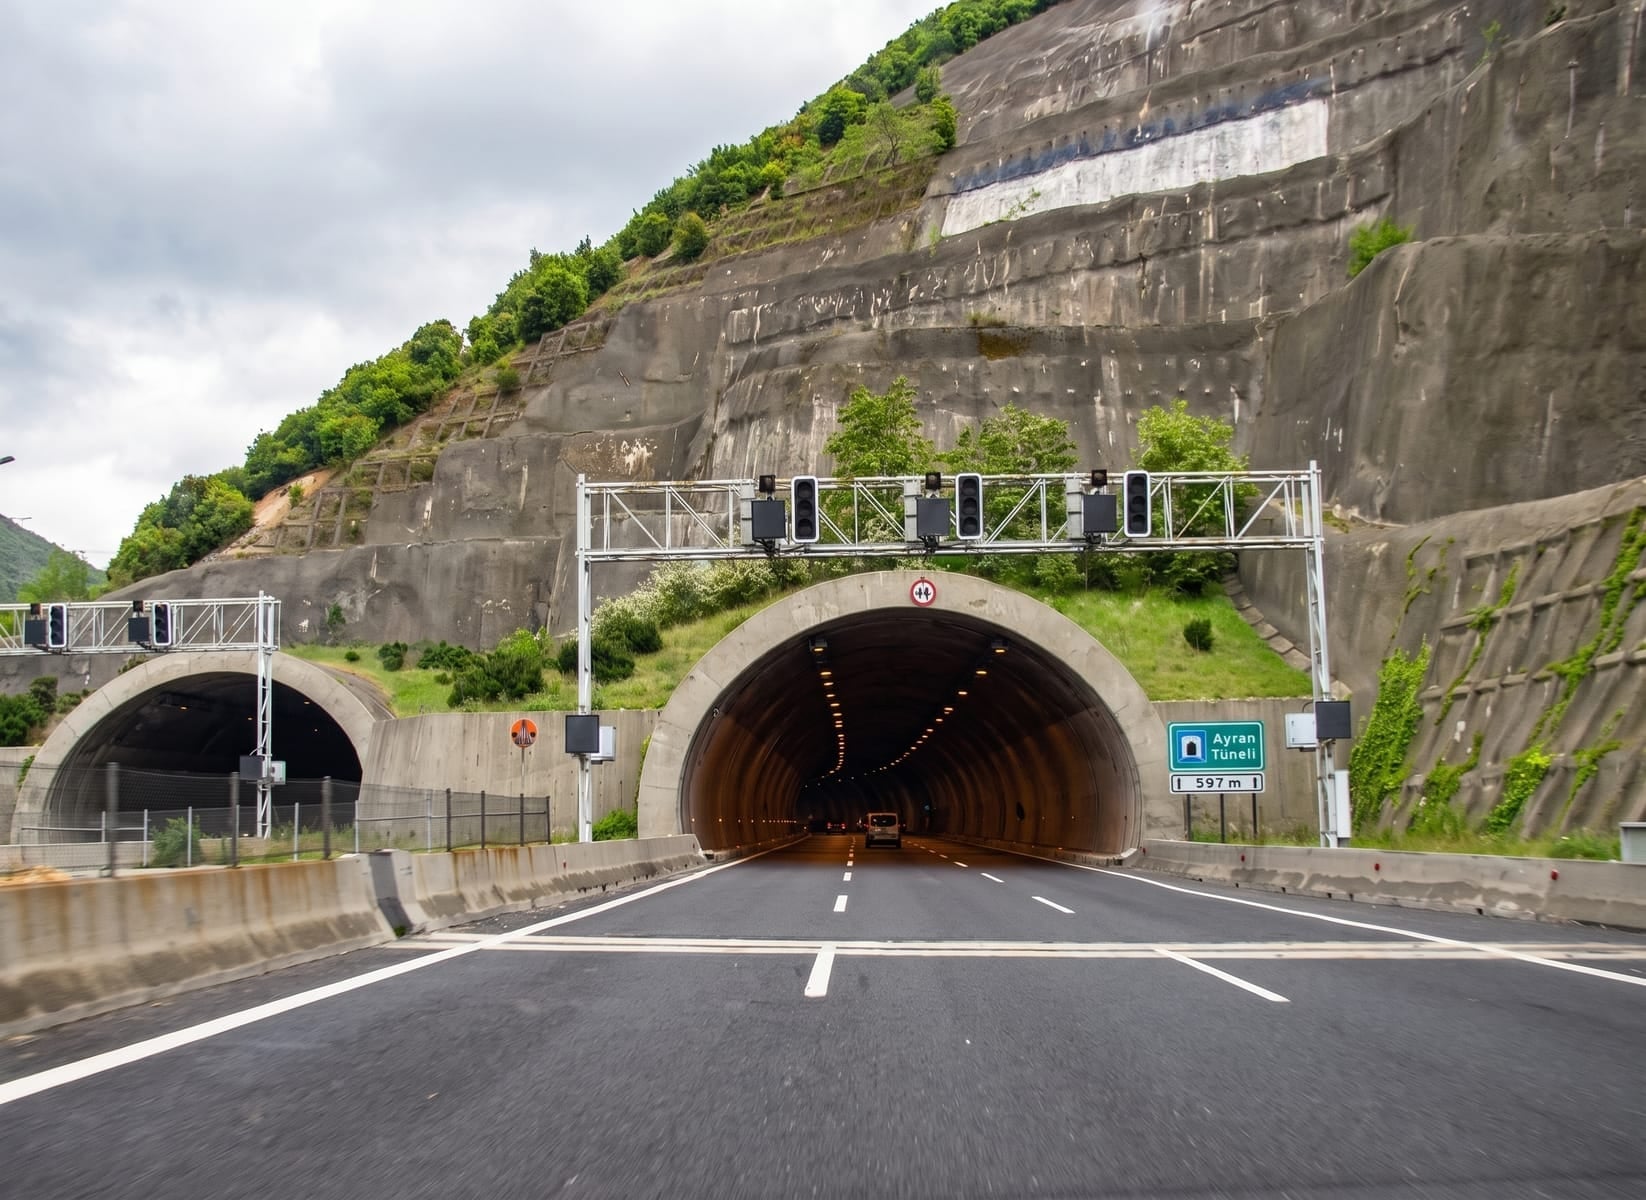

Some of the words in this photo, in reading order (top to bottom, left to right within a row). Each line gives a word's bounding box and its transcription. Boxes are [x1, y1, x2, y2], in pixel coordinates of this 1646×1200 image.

[1213, 733, 1256, 747] Ayran
[1211, 748, 1256, 760] Tüneli
[1196, 777, 1224, 788] 597
[1228, 779, 1241, 788] m
